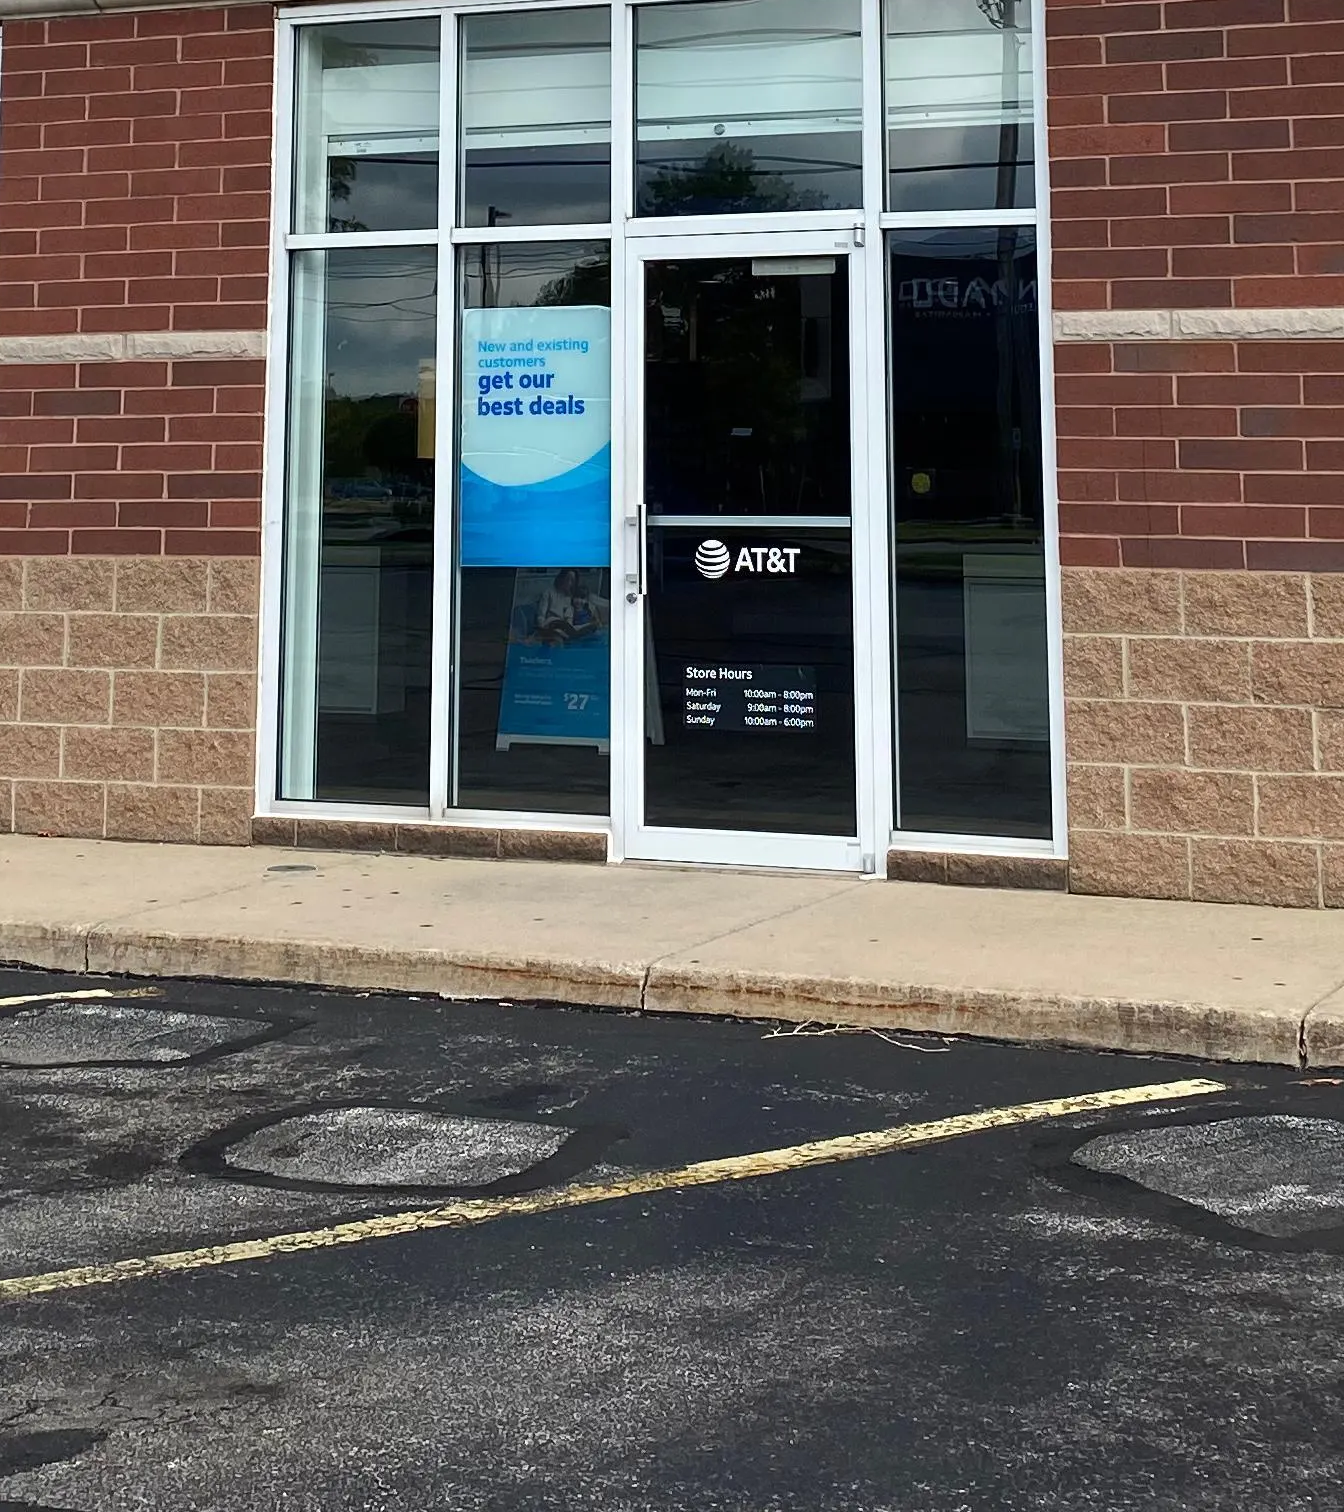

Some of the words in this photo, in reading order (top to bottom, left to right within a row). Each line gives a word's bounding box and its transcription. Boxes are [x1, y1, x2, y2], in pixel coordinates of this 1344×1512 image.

[478, 341, 506, 352] New
[510, 339, 533, 352] and
[537, 338, 589, 354] existing
[478, 357, 546, 368] customers
[478, 371, 514, 395] get
[519, 373, 555, 389] our
[478, 396, 524, 416] best
[529, 394, 585, 415] deals
[734, 546, 801, 573] AT&T
[686, 667, 717, 679] Store
[719, 668, 753, 680] Hours
[686, 688, 717, 697] Mon-Fri
[743, 689, 777, 699] 10:00am
[783, 690, 814, 701] 8:00pm
[686, 701, 722, 713] Saturday
[747, 703, 777, 713] 9:00am
[783, 704, 814, 715] 8:00pm
[686, 714, 716, 726] Sunday
[744, 716, 777, 726] 10:00am
[783, 717, 814, 729] 6:00pm
